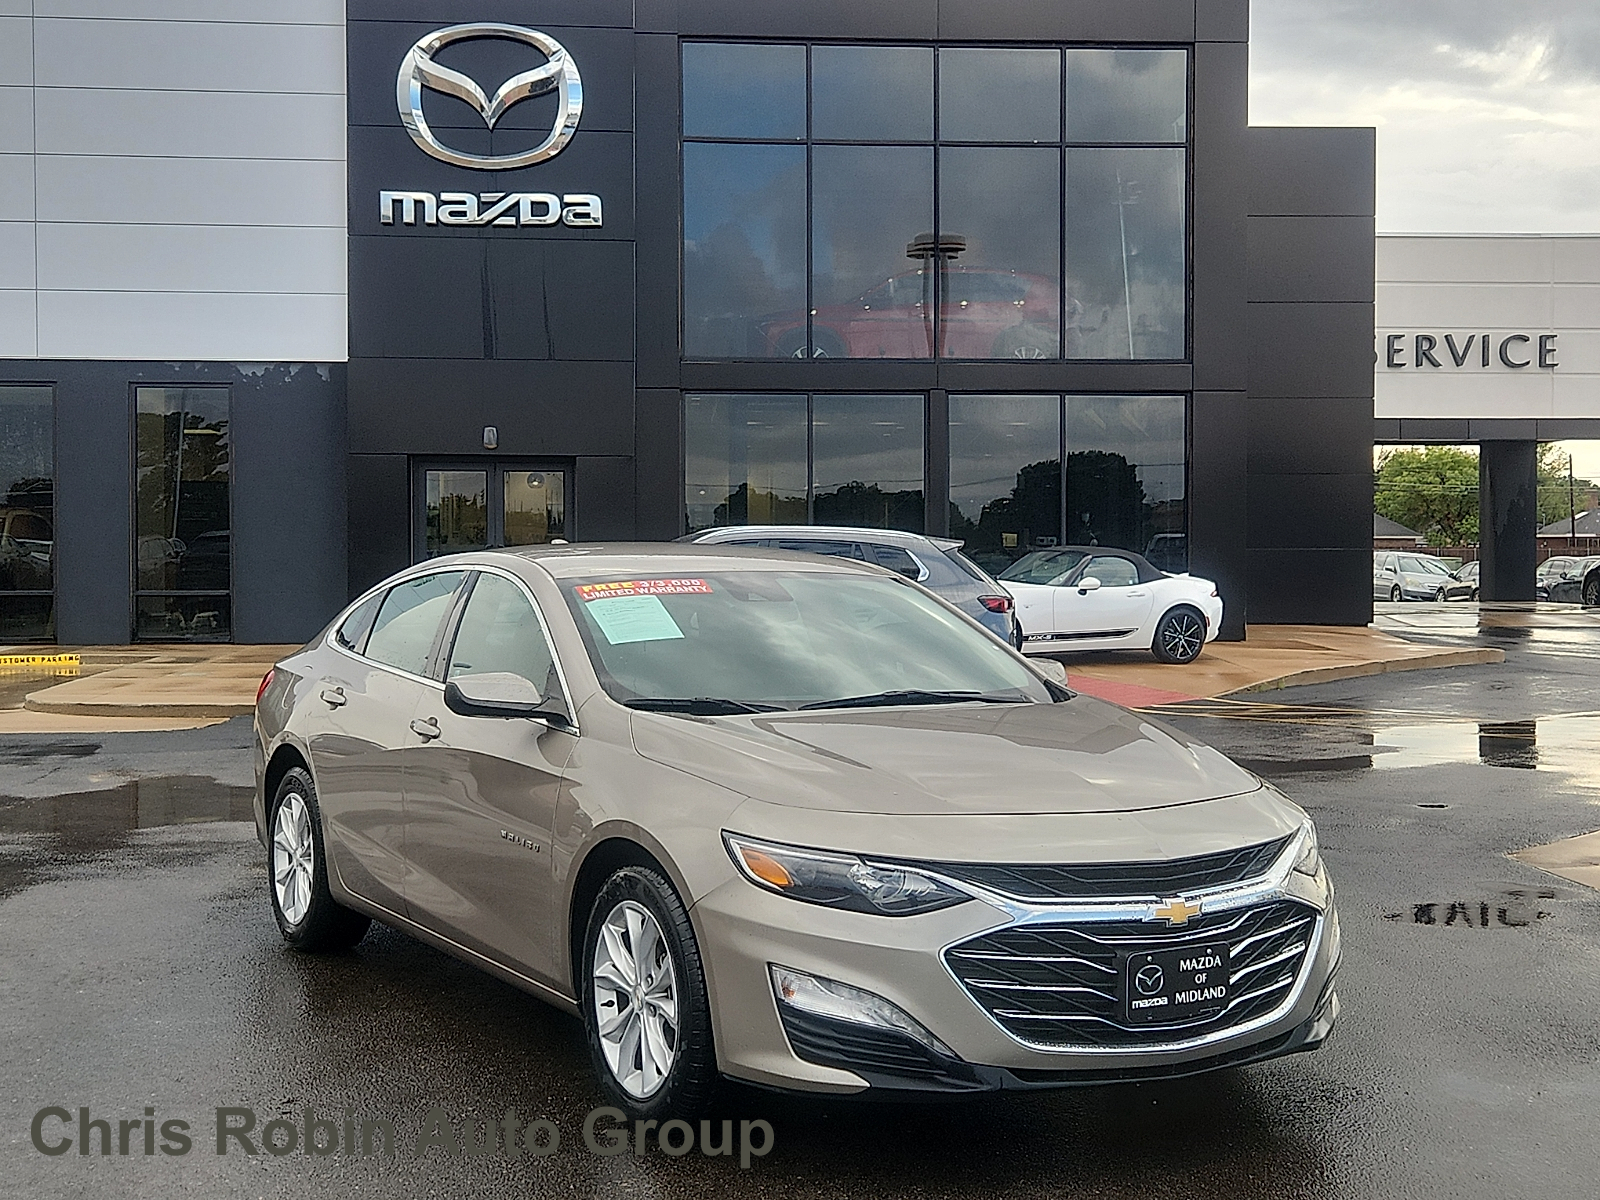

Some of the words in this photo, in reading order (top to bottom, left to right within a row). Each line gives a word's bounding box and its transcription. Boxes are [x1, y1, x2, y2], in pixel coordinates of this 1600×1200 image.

[1374, 333, 1559, 368] ERVICE
[582, 582, 634, 592] FREE
[583, 589, 635, 599] LIMITED
[636, 586, 708, 594] WARRANTY
[1180, 955, 1222, 972] MAZDA
[1195, 972, 1208, 984] OF
[1175, 986, 1226, 1004] MIDLAND
[1131, 996, 1168, 1009] mazda
